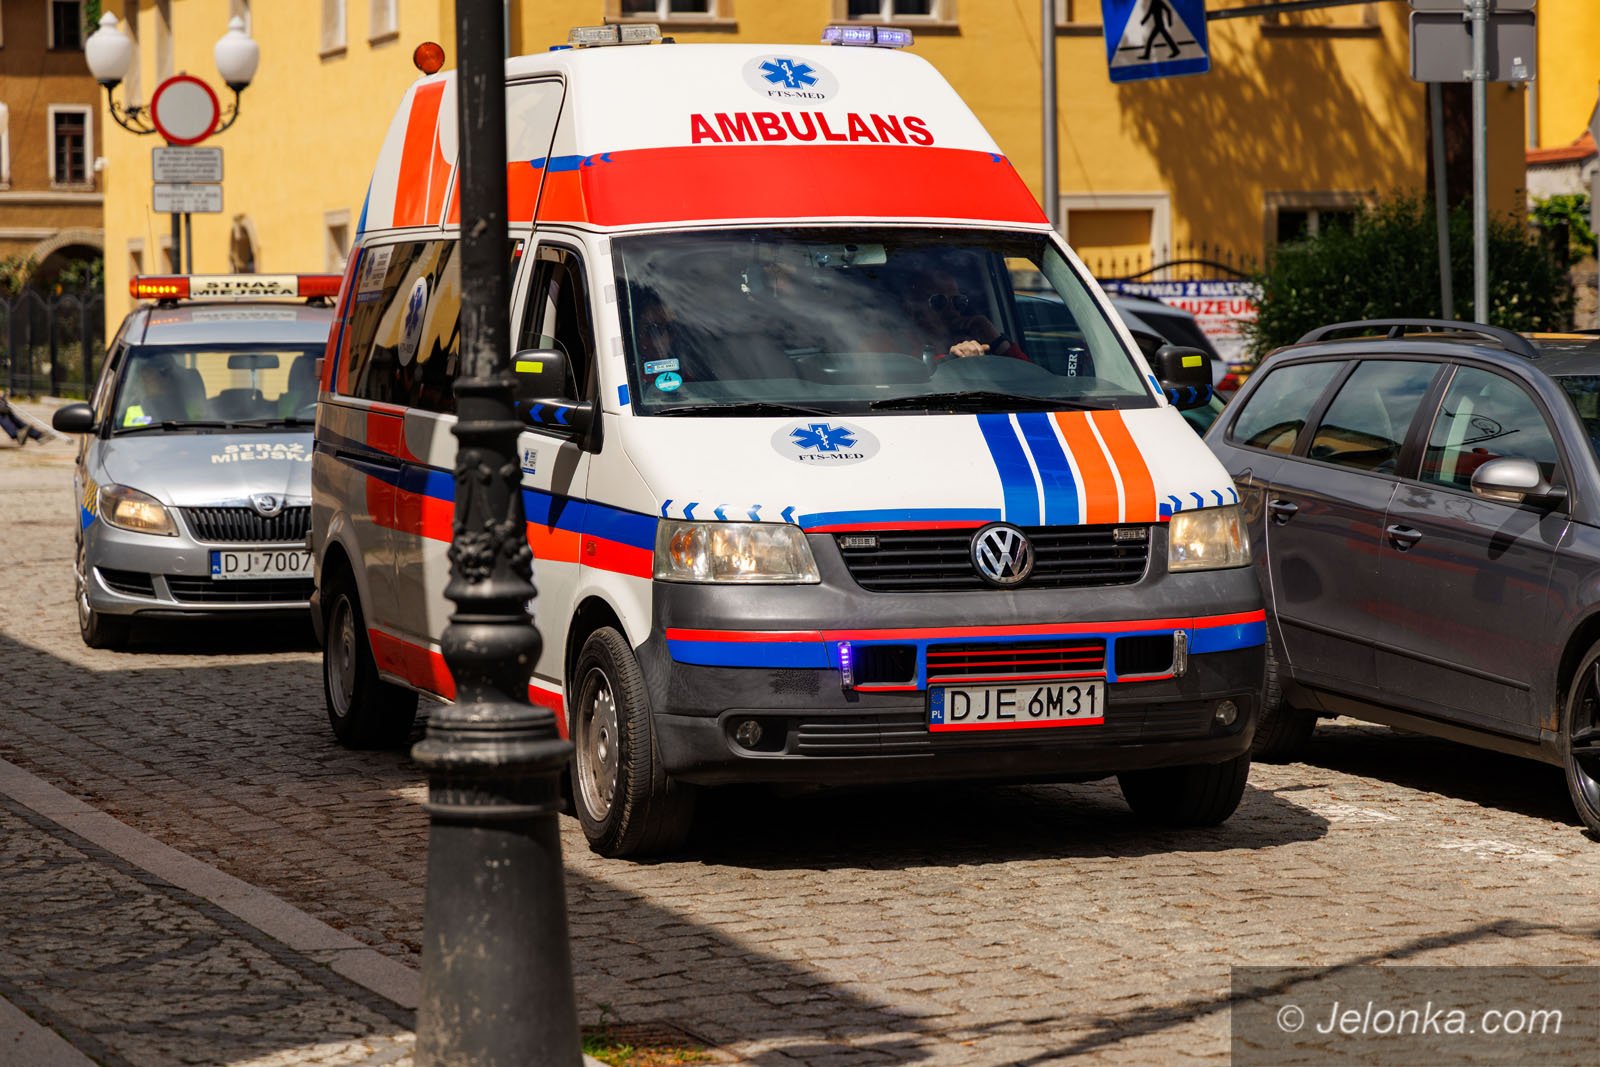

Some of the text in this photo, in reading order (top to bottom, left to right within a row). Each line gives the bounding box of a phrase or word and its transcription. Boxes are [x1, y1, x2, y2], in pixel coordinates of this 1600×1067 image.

[767, 90, 825, 100] FTS-MED
[690, 112, 935, 146] AMBULANS
[798, 453, 864, 461] FTS-MED
[225, 552, 313, 573] DJ 7007
[950, 684, 1096, 721] DJE 6M31
[931, 710, 943, 719] PL
